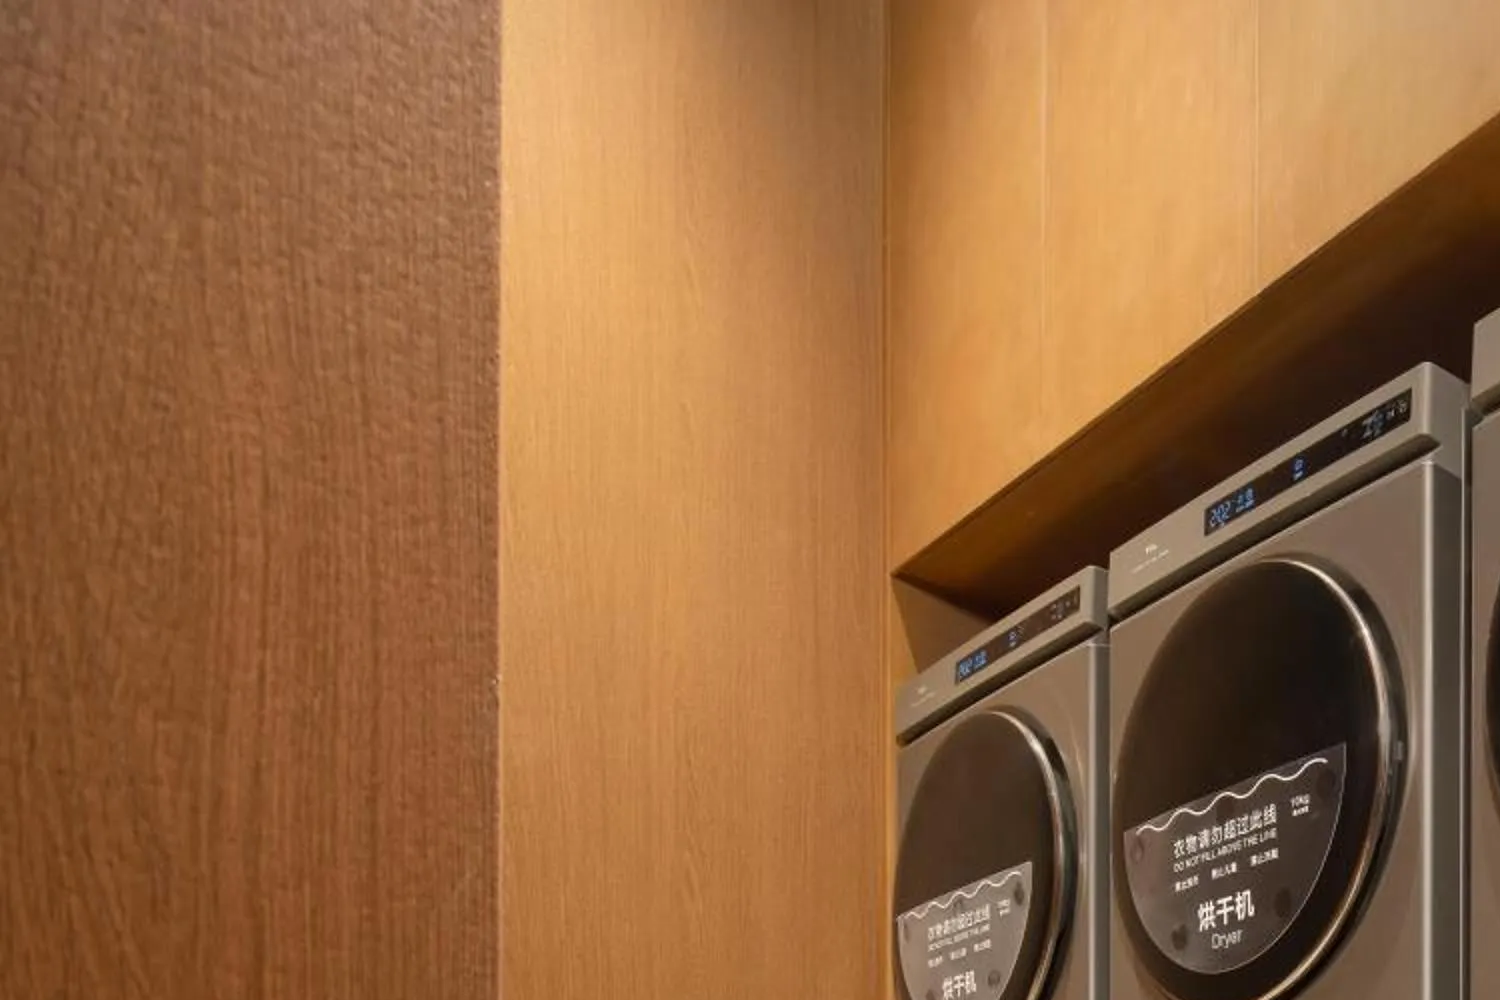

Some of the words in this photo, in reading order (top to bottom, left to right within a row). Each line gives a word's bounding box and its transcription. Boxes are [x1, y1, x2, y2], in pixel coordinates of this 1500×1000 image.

[1197, 889, 1255, 932] 烘干机
[1211, 928, 1243, 949] Dryer
